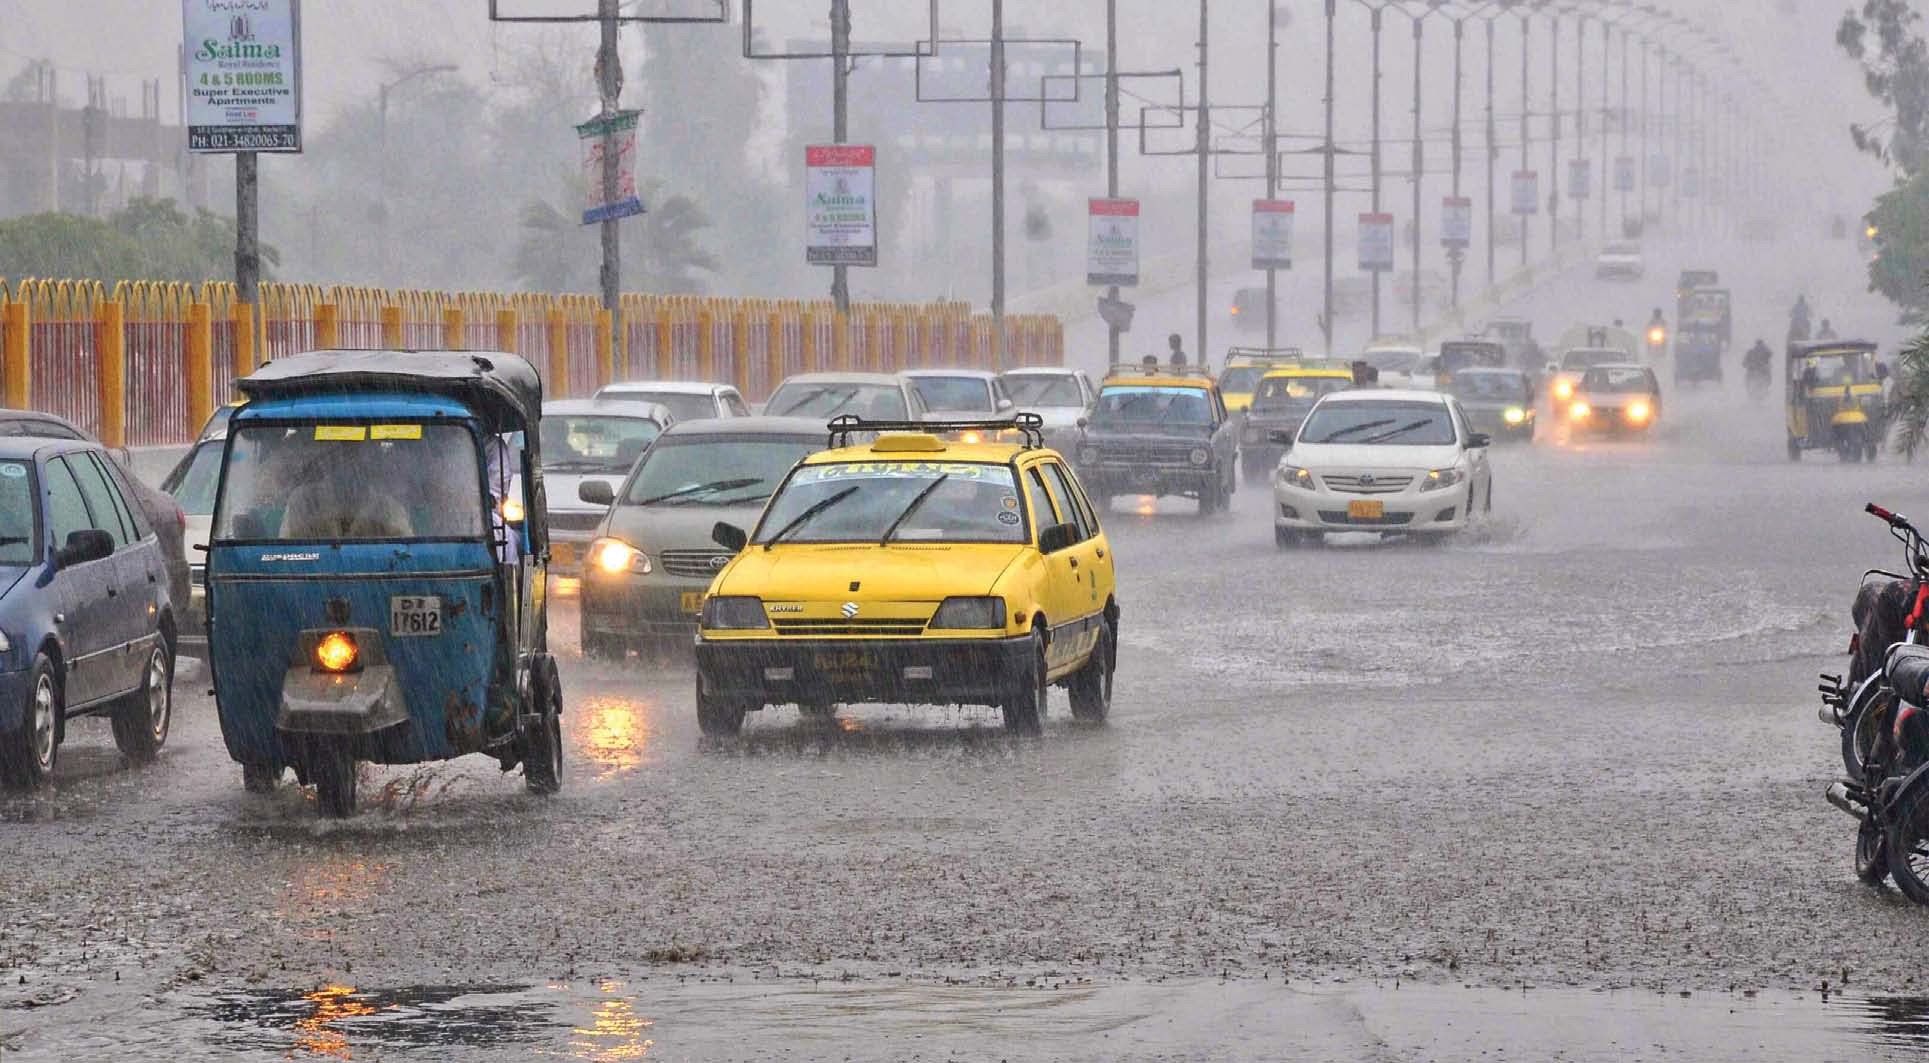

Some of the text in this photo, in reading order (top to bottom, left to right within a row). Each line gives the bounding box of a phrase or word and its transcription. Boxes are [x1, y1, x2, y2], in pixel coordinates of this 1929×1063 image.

[195, 39, 280, 61] Saima
[200, 71, 283, 86] 4 & 5 ROOMS
[193, 87, 290, 98] Super Executive
[208, 97, 276, 106] Apartments
[394, 611, 439, 633] 17612
